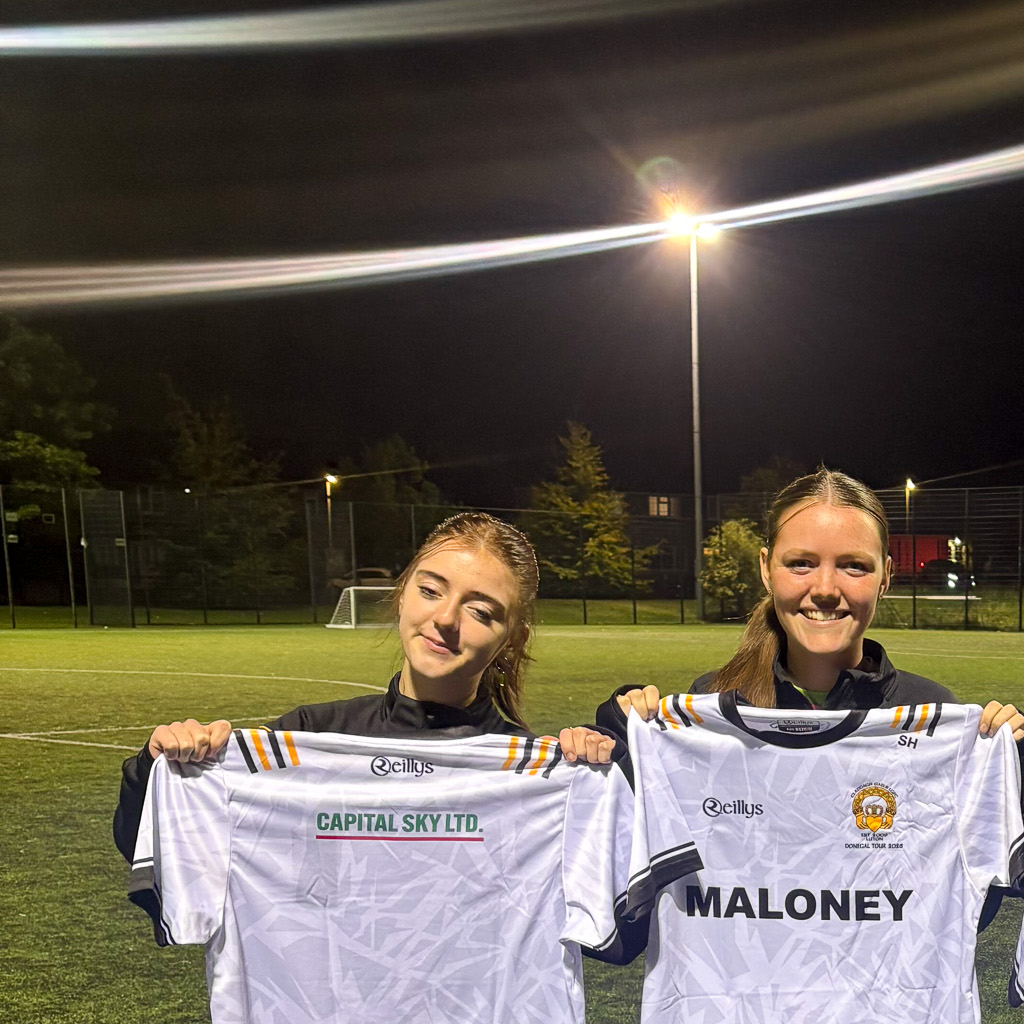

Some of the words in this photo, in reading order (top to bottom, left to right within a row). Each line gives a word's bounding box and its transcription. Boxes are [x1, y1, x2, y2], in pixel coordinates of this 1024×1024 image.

[898, 735, 918, 749] SH
[371, 755, 434, 777] Reillys
[702, 797, 764, 819] Reillys
[317, 812, 398, 832] CAPITAL
[402, 813, 442, 832] SKY
[445, 814, 483, 833] LTD.
[686, 885, 914, 922] MALONEY
